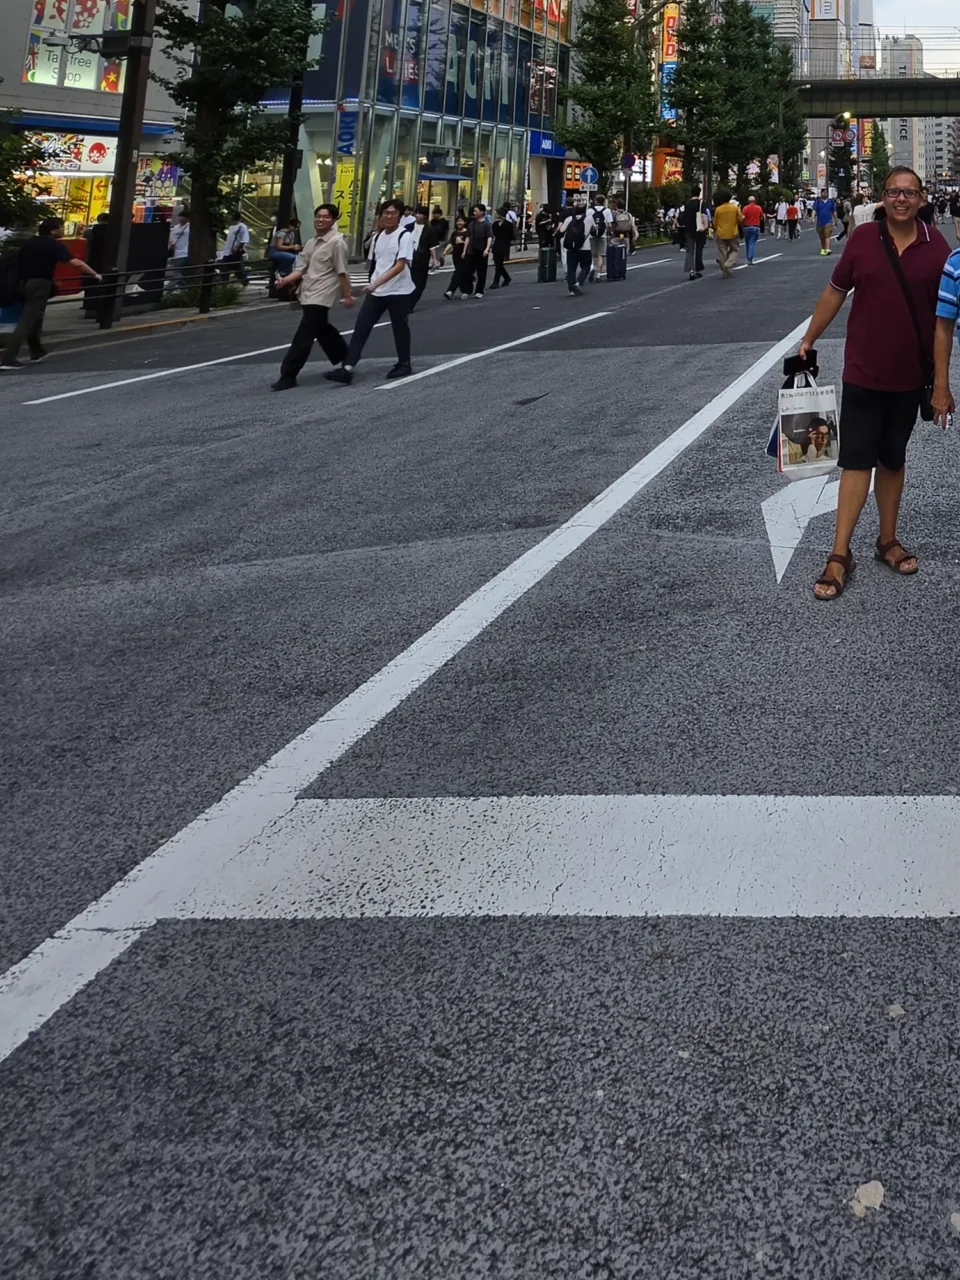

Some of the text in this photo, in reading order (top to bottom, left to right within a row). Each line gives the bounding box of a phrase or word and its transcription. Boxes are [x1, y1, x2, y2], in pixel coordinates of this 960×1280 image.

[45, 49, 92, 69] Ta-free
[52, 69, 82, 84] Sop
[337, 111, 356, 156] AOKI
